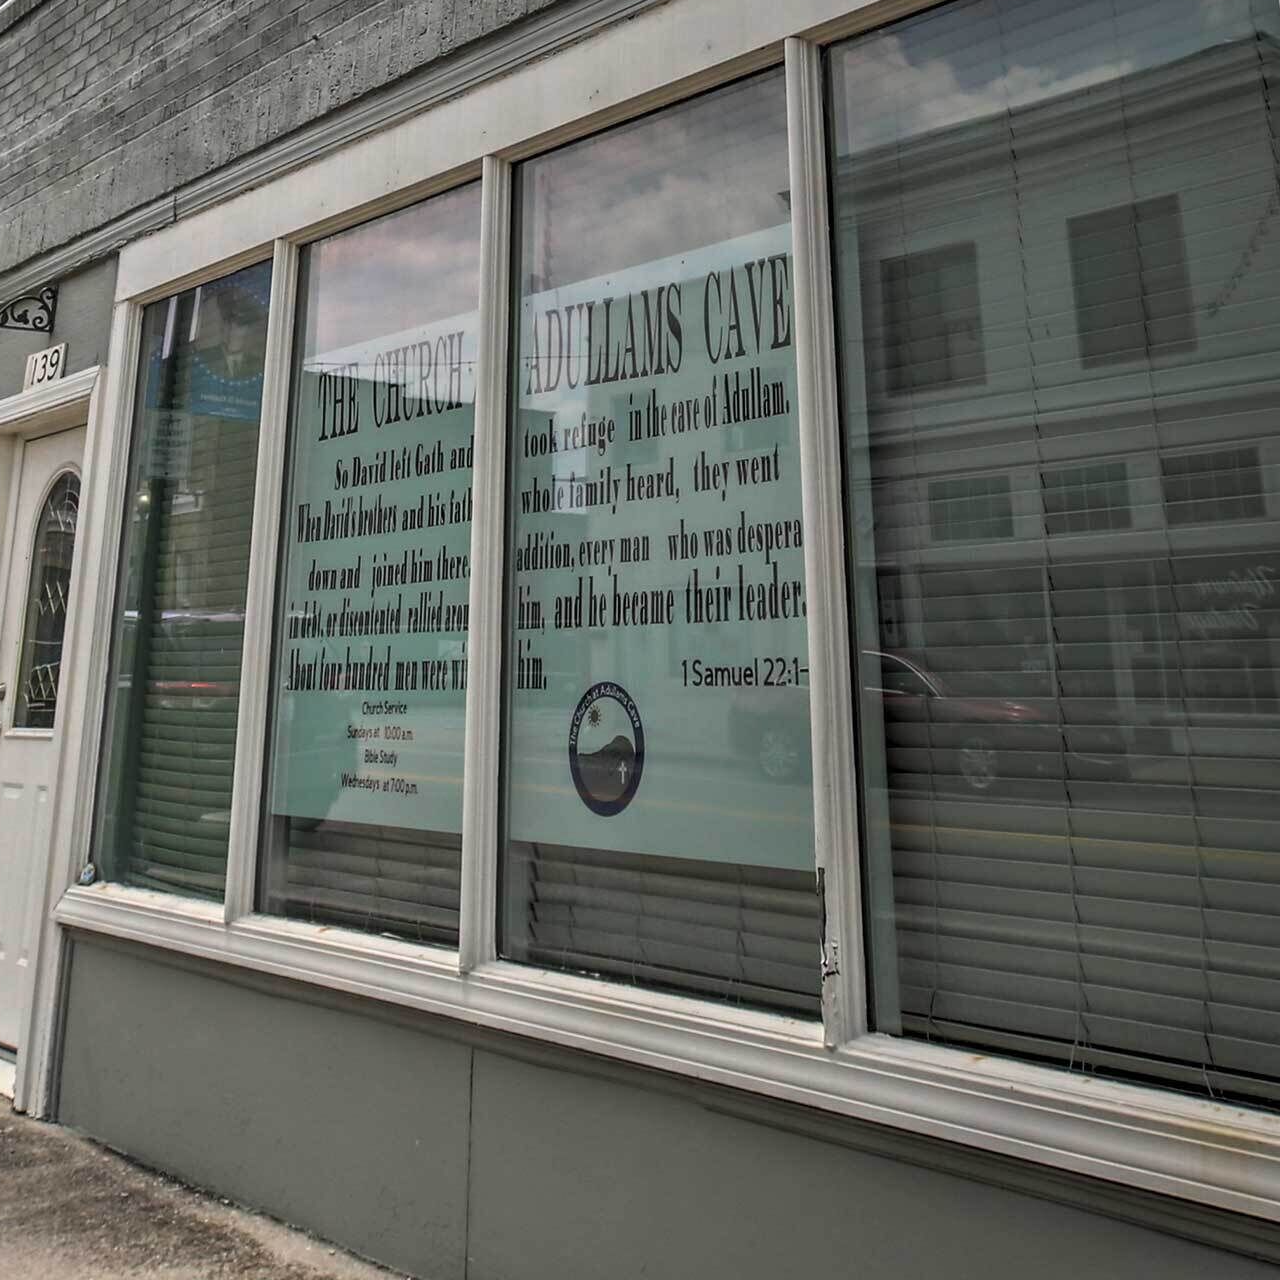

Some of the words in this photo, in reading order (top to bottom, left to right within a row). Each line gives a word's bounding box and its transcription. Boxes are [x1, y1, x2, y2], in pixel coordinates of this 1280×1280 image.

[318, 363, 359, 441] THE
[373, 331, 464, 428] CHURCH
[525, 282, 683, 395] ADULLAMS
[703, 252, 791, 364] CAVE
[30, 349, 60, 385] 139
[334, 459, 348, 490] So
[352, 451, 386, 487] David
[391, 446, 411, 481] left
[415, 440, 443, 477] Gath
[451, 435, 474, 470] and
[524, 419, 557, 458] took
[564, 411, 615, 456] refuge
[628, 392, 642, 442] in
[646, 388, 667, 438] the
[671, 397, 700, 432] cave
[704, 375, 718, 430] of
[722, 367, 790, 426] Adullam.
[297, 503, 321, 543] When
[323, 496, 356, 540] David's
[357, 494, 397, 536] brothers
[402, 496, 424, 531] and
[427, 492, 445, 527] his
[521, 477, 563, 514] whole
[570, 467, 620, 514] family
[626, 457, 680, 503] heard,
[693, 451, 729, 501] they
[736, 443, 780, 486] went
[308, 560, 336, 591] down
[340, 556, 361, 589] and
[371, 550, 408, 597] joined
[411, 548, 433, 583] him
[517, 531, 575, 572] addition,
[579, 538, 615, 576] every
[620, 535, 650, 563] man
[668, 519, 697, 561] who
[704, 525, 732, 556] was
[737, 511, 802, 565] despera
[289, 602, 299, 639] in
[326, 612, 337, 637] or
[339, 593, 402, 637] discontented
[407, 590, 443, 634] rallied
[518, 586, 545, 634] him,
[554, 576, 582, 628] and
[589, 576, 607, 627] he
[612, 573, 674, 626] became
[685, 567, 731, 624] their
[738, 561, 807, 621] leader.
[287, 648, 317, 690] About
[320, 646, 341, 690] four
[344, 646, 391, 690] hundred
[395, 660, 417, 690] men
[422, 659, 447, 690] were
[517, 639, 547, 690] him.
[682, 660, 688, 687] 1
[692, 658, 758, 687] Samuel
[362, 701, 383, 715] Church
[384, 700, 408, 714] Service
[574, 693, 593, 726] Church
[347, 725, 372, 741] Sundays
[373, 726, 380, 738] at
[570, 726, 579, 745] The
[364, 749, 378, 763] Bible
[380, 750, 398, 767] Study
[341, 772, 380, 792] Wednesdays
[382, 780, 389, 792] at
